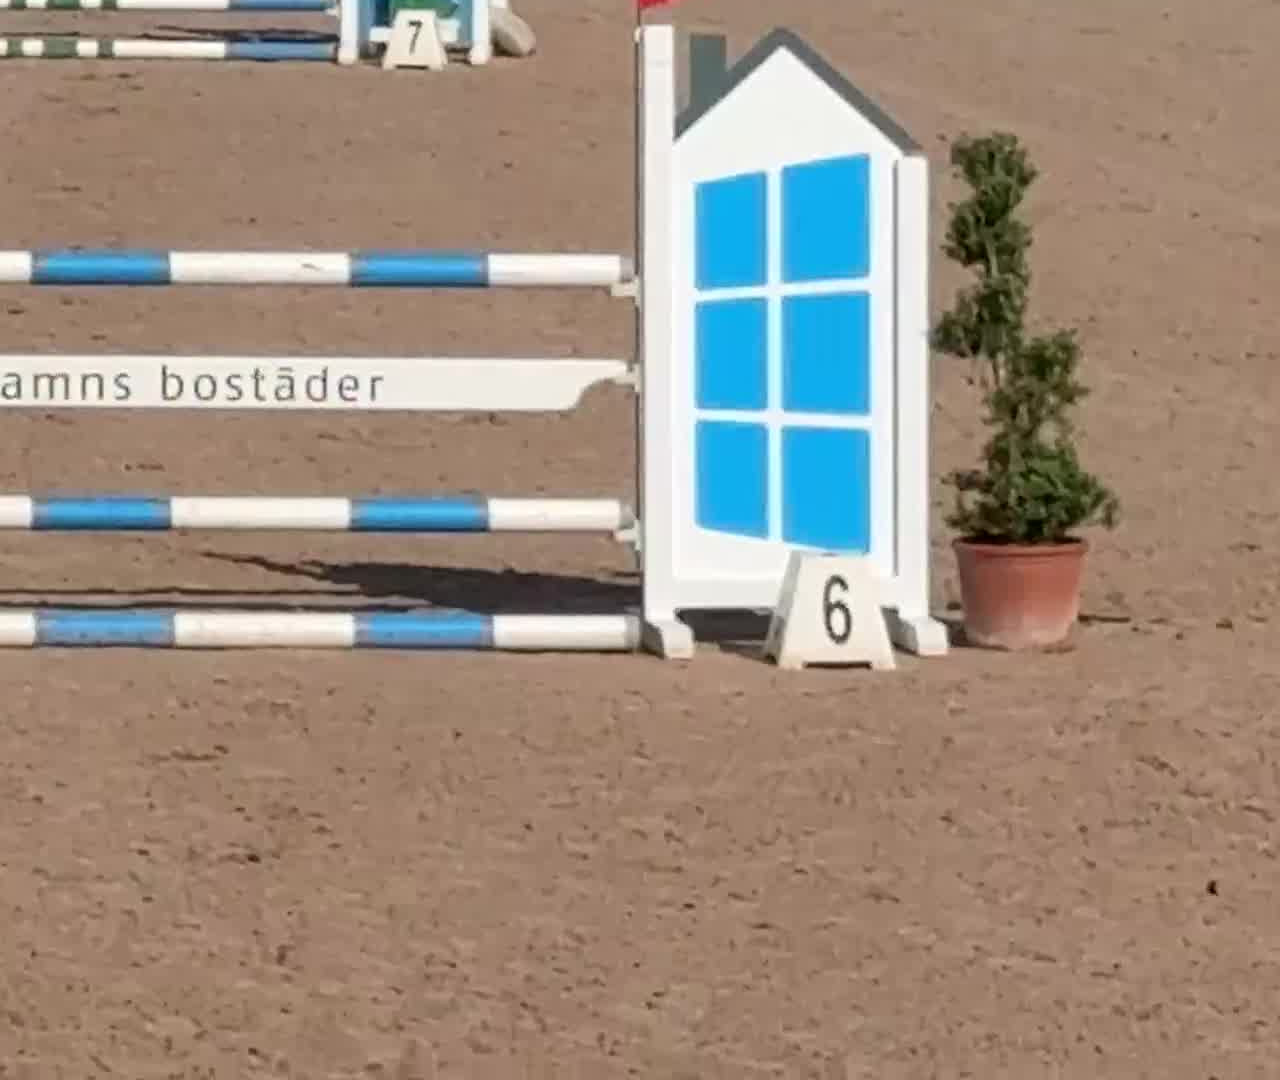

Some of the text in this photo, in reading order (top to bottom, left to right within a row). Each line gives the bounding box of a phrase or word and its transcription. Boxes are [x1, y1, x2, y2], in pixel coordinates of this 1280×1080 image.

[408, 20, 423, 56] 7
[160, 365, 385, 403] bostäder
[823, 574, 852, 645] 6
